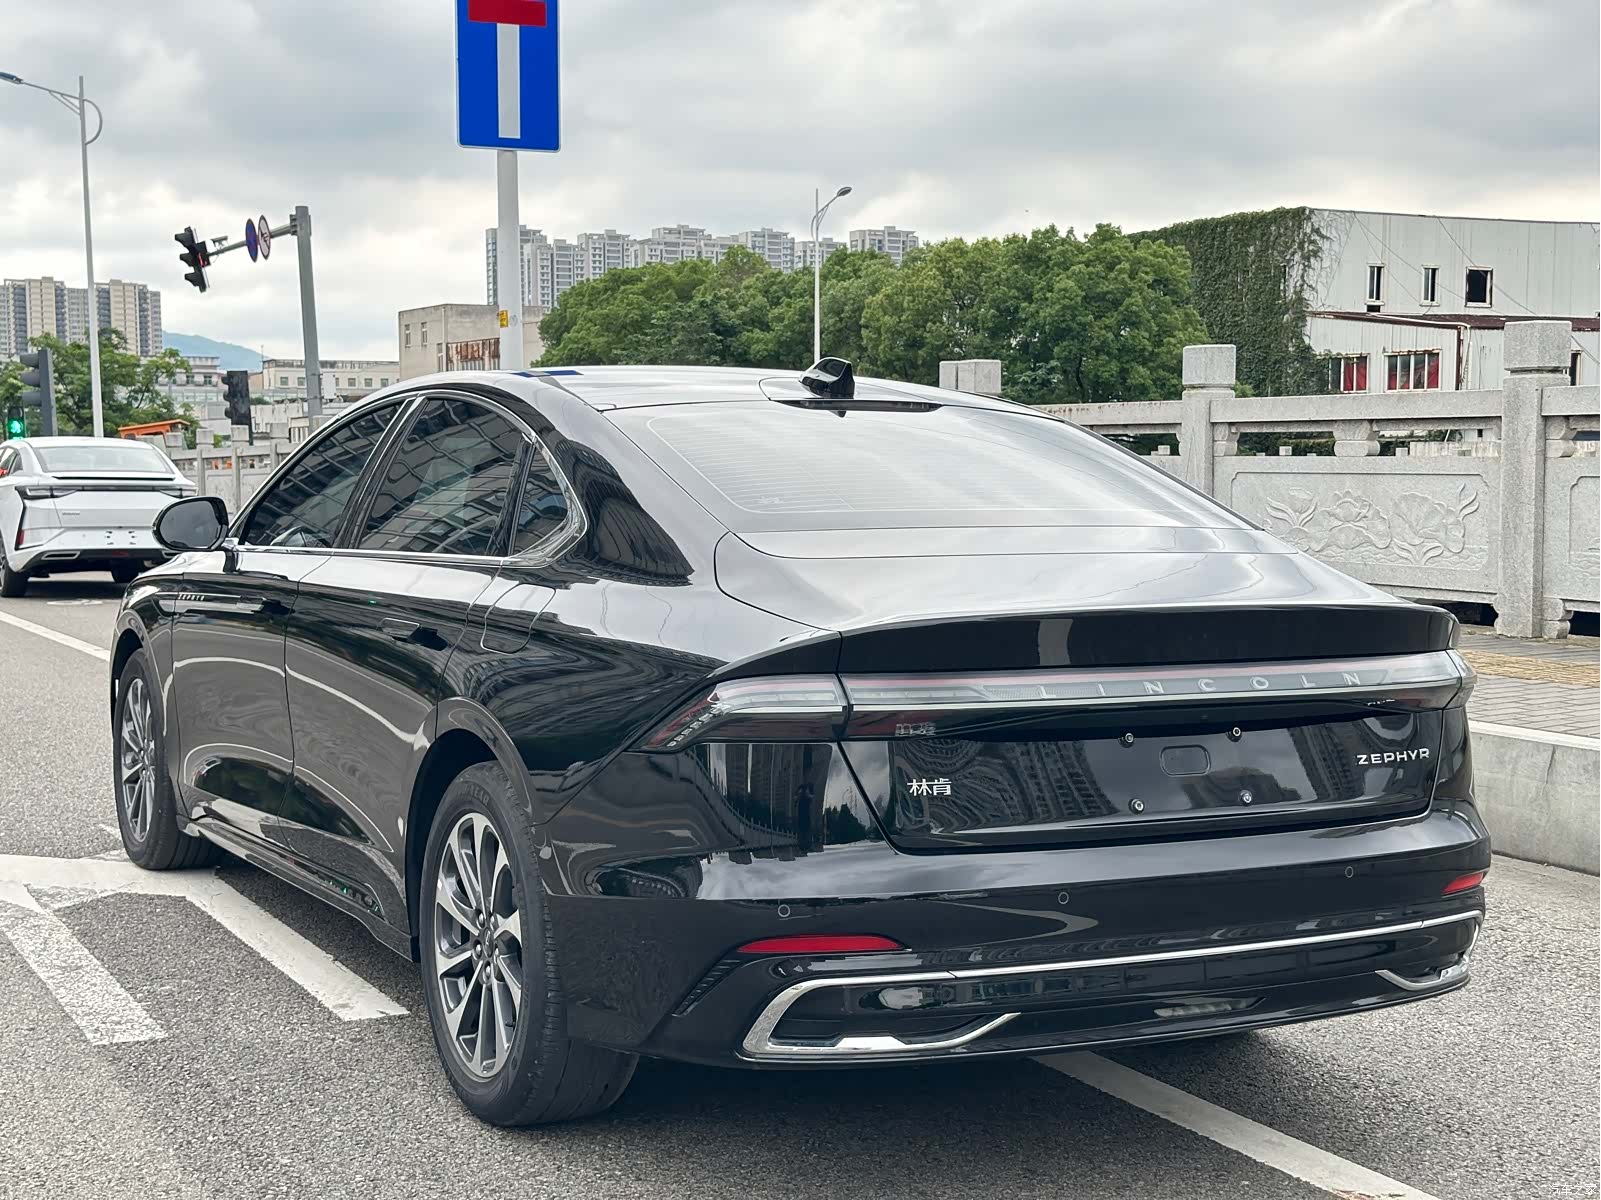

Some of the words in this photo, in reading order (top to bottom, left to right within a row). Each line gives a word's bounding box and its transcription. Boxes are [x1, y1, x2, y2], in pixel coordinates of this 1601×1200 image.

[1037, 672, 1362, 699] LINCOLN
[1356, 748, 1430, 765] ZEPHYR
[907, 778, 952, 796] 林肯
